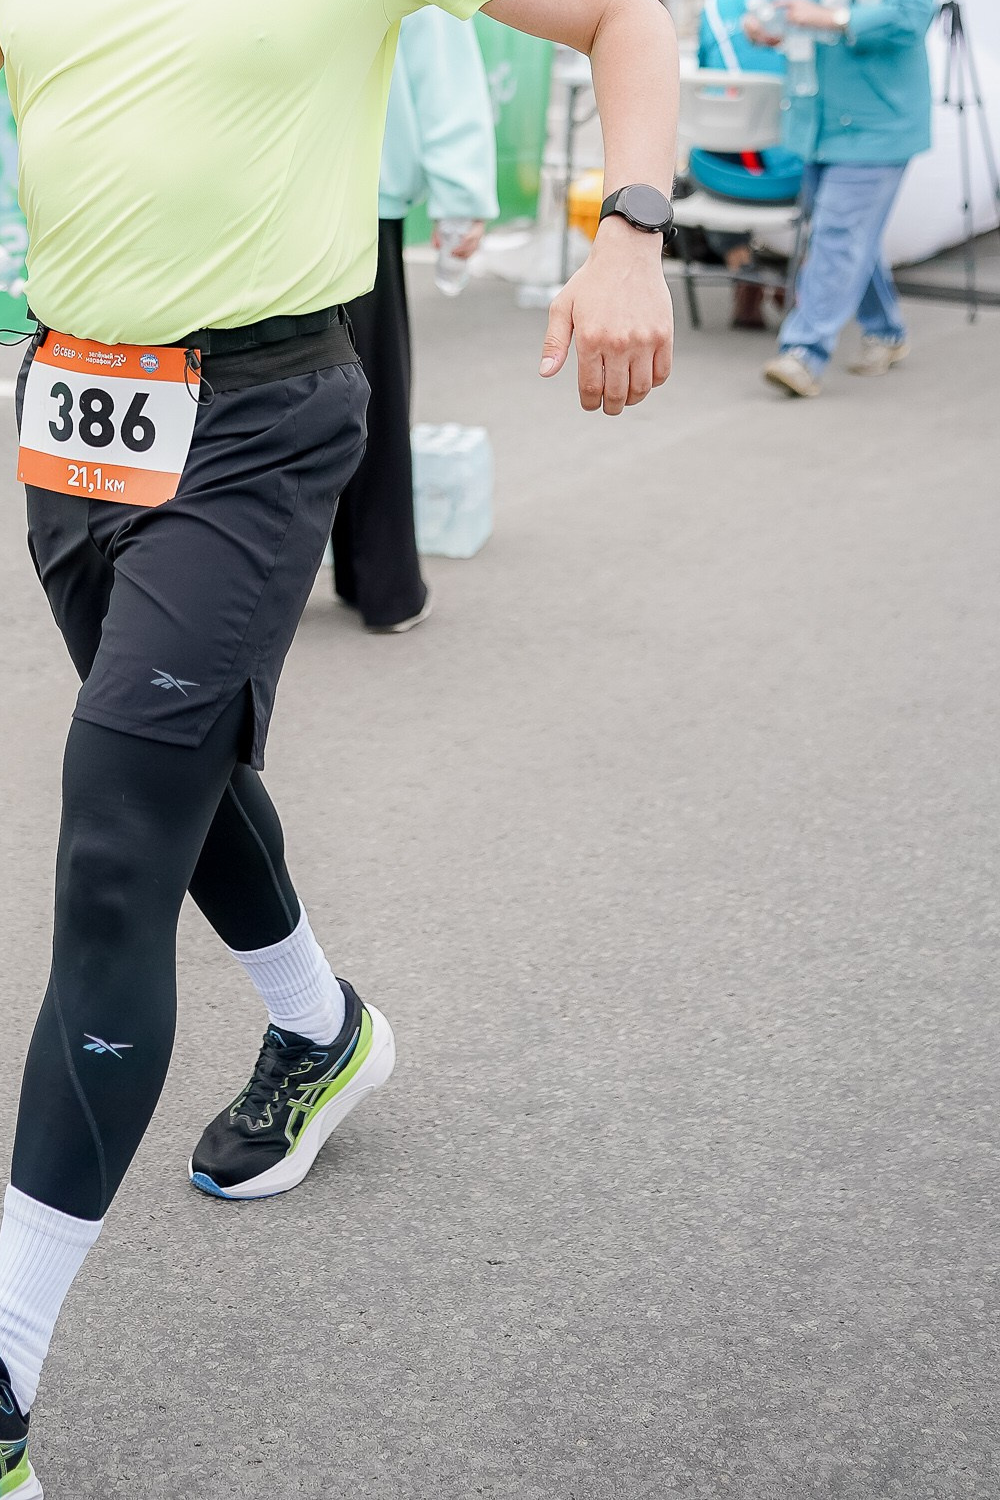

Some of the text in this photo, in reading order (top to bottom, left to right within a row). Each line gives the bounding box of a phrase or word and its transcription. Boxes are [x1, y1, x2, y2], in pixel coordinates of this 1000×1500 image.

[60, 347, 76, 358] СБЕР
[48, 381, 156, 452] 386
[67, 464, 102, 493] 21,1
